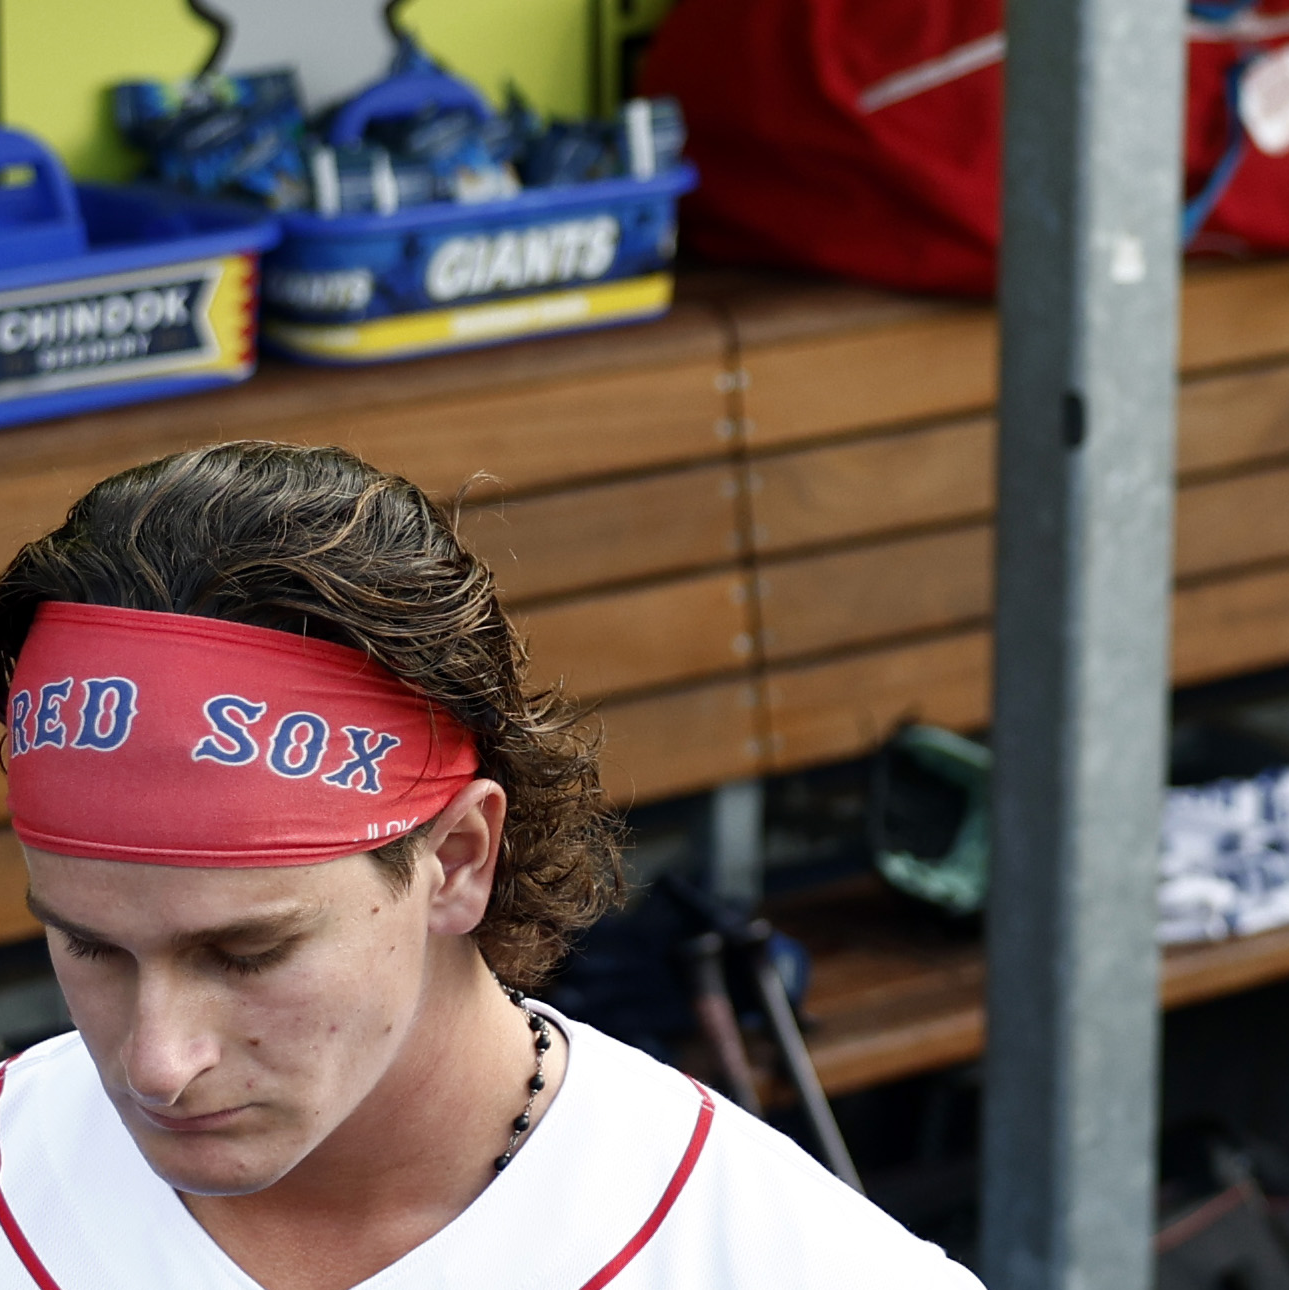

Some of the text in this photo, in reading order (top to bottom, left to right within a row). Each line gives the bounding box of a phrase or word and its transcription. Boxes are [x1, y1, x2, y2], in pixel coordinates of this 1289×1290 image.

[426, 214, 621, 300] GIANTS
[10, 676, 401, 794] RED SOX
